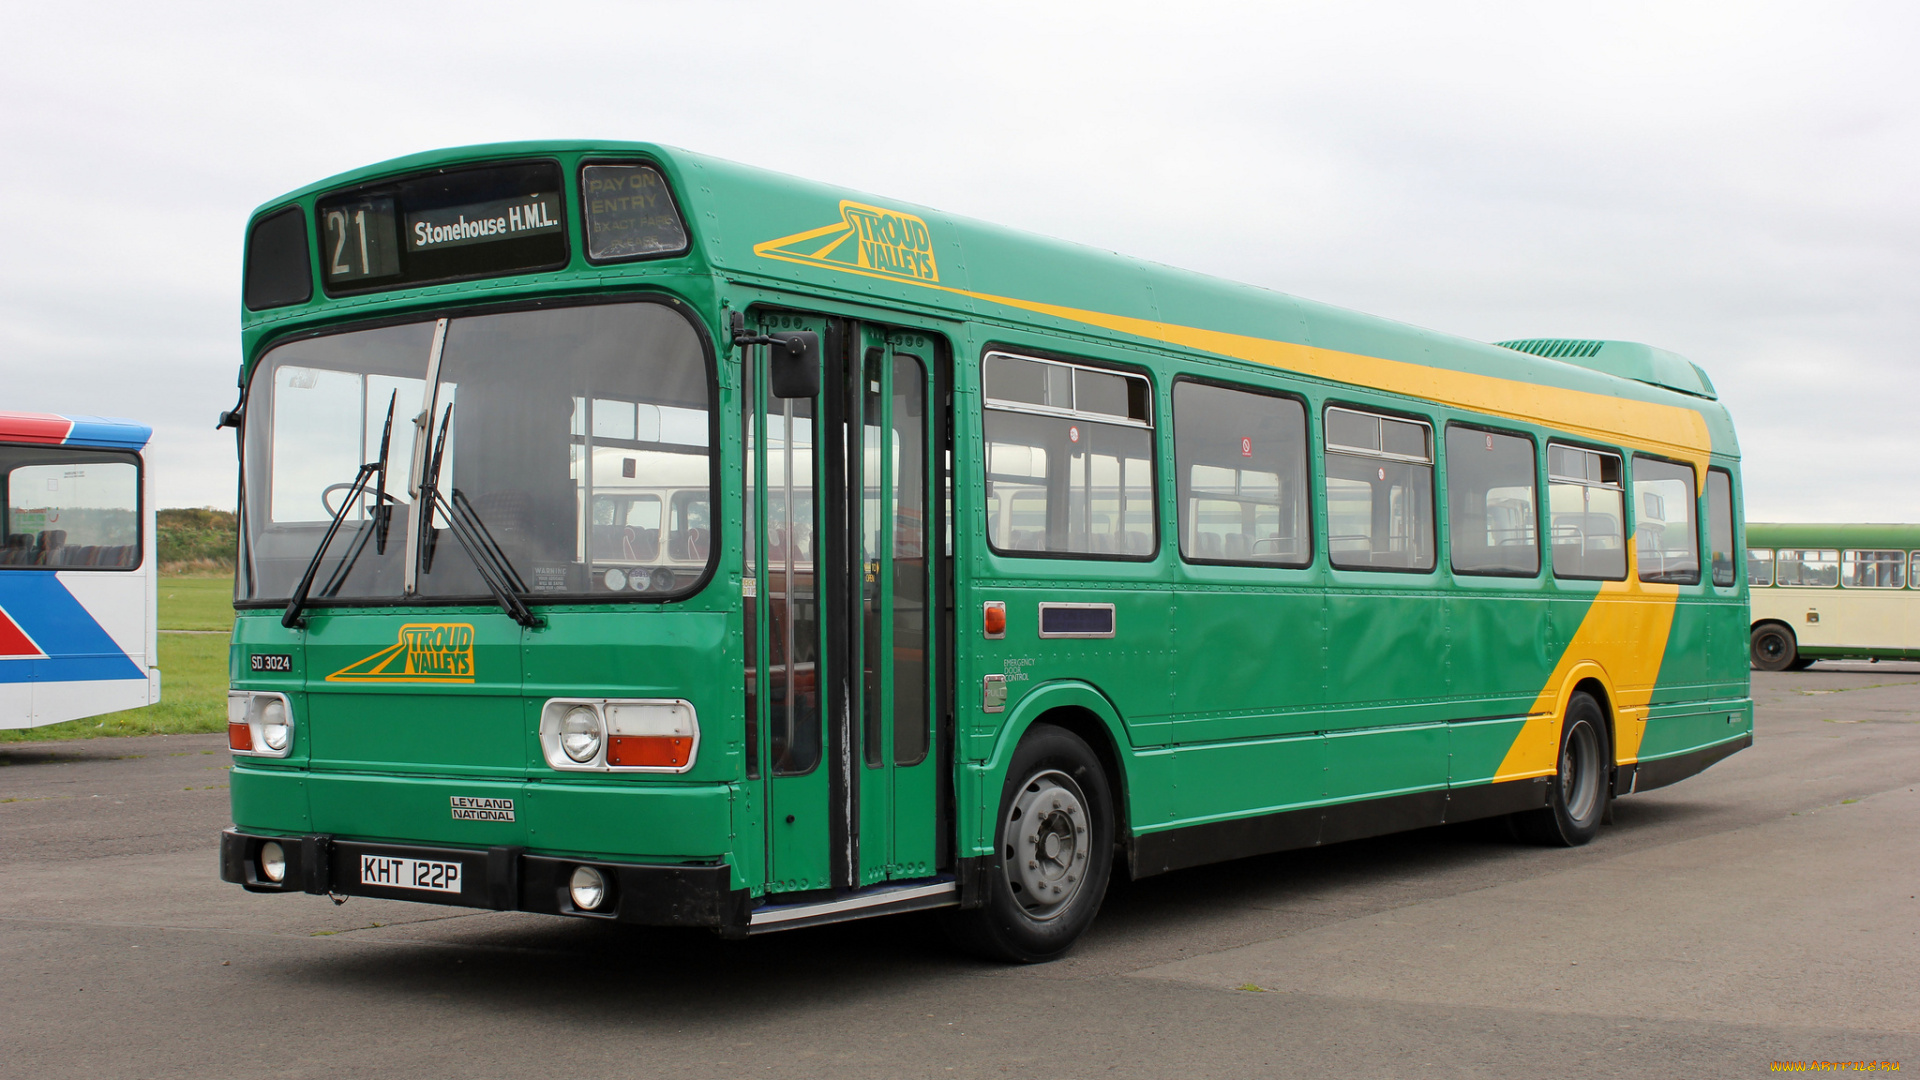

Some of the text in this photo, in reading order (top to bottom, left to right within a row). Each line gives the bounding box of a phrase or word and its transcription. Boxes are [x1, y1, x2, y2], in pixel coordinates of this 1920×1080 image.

[589, 173, 656, 193] PAY ON
[591, 194, 657, 214] ENTRY
[414, 202, 558, 246] Stonehouse H.M.L.
[593, 219, 635, 233] EXACT
[844, 206, 930, 253] STROUD
[328, 210, 369, 275] 21
[861, 241, 934, 279] VALLEYS
[534, 567, 567, 575] WARNING
[403, 626, 474, 653] STROUD
[251, 655, 290, 670] SD 3024
[410, 653, 470, 675] VALLEYS
[1003, 658, 1036, 667] EMERGENCY
[1004, 666, 1022, 675] DOOR
[1004, 673, 1029, 682] CONTROL
[451, 797, 513, 809] LEYLAND
[453, 809, 514, 821] NATIONAL
[364, 857, 458, 889] KHT 122P
